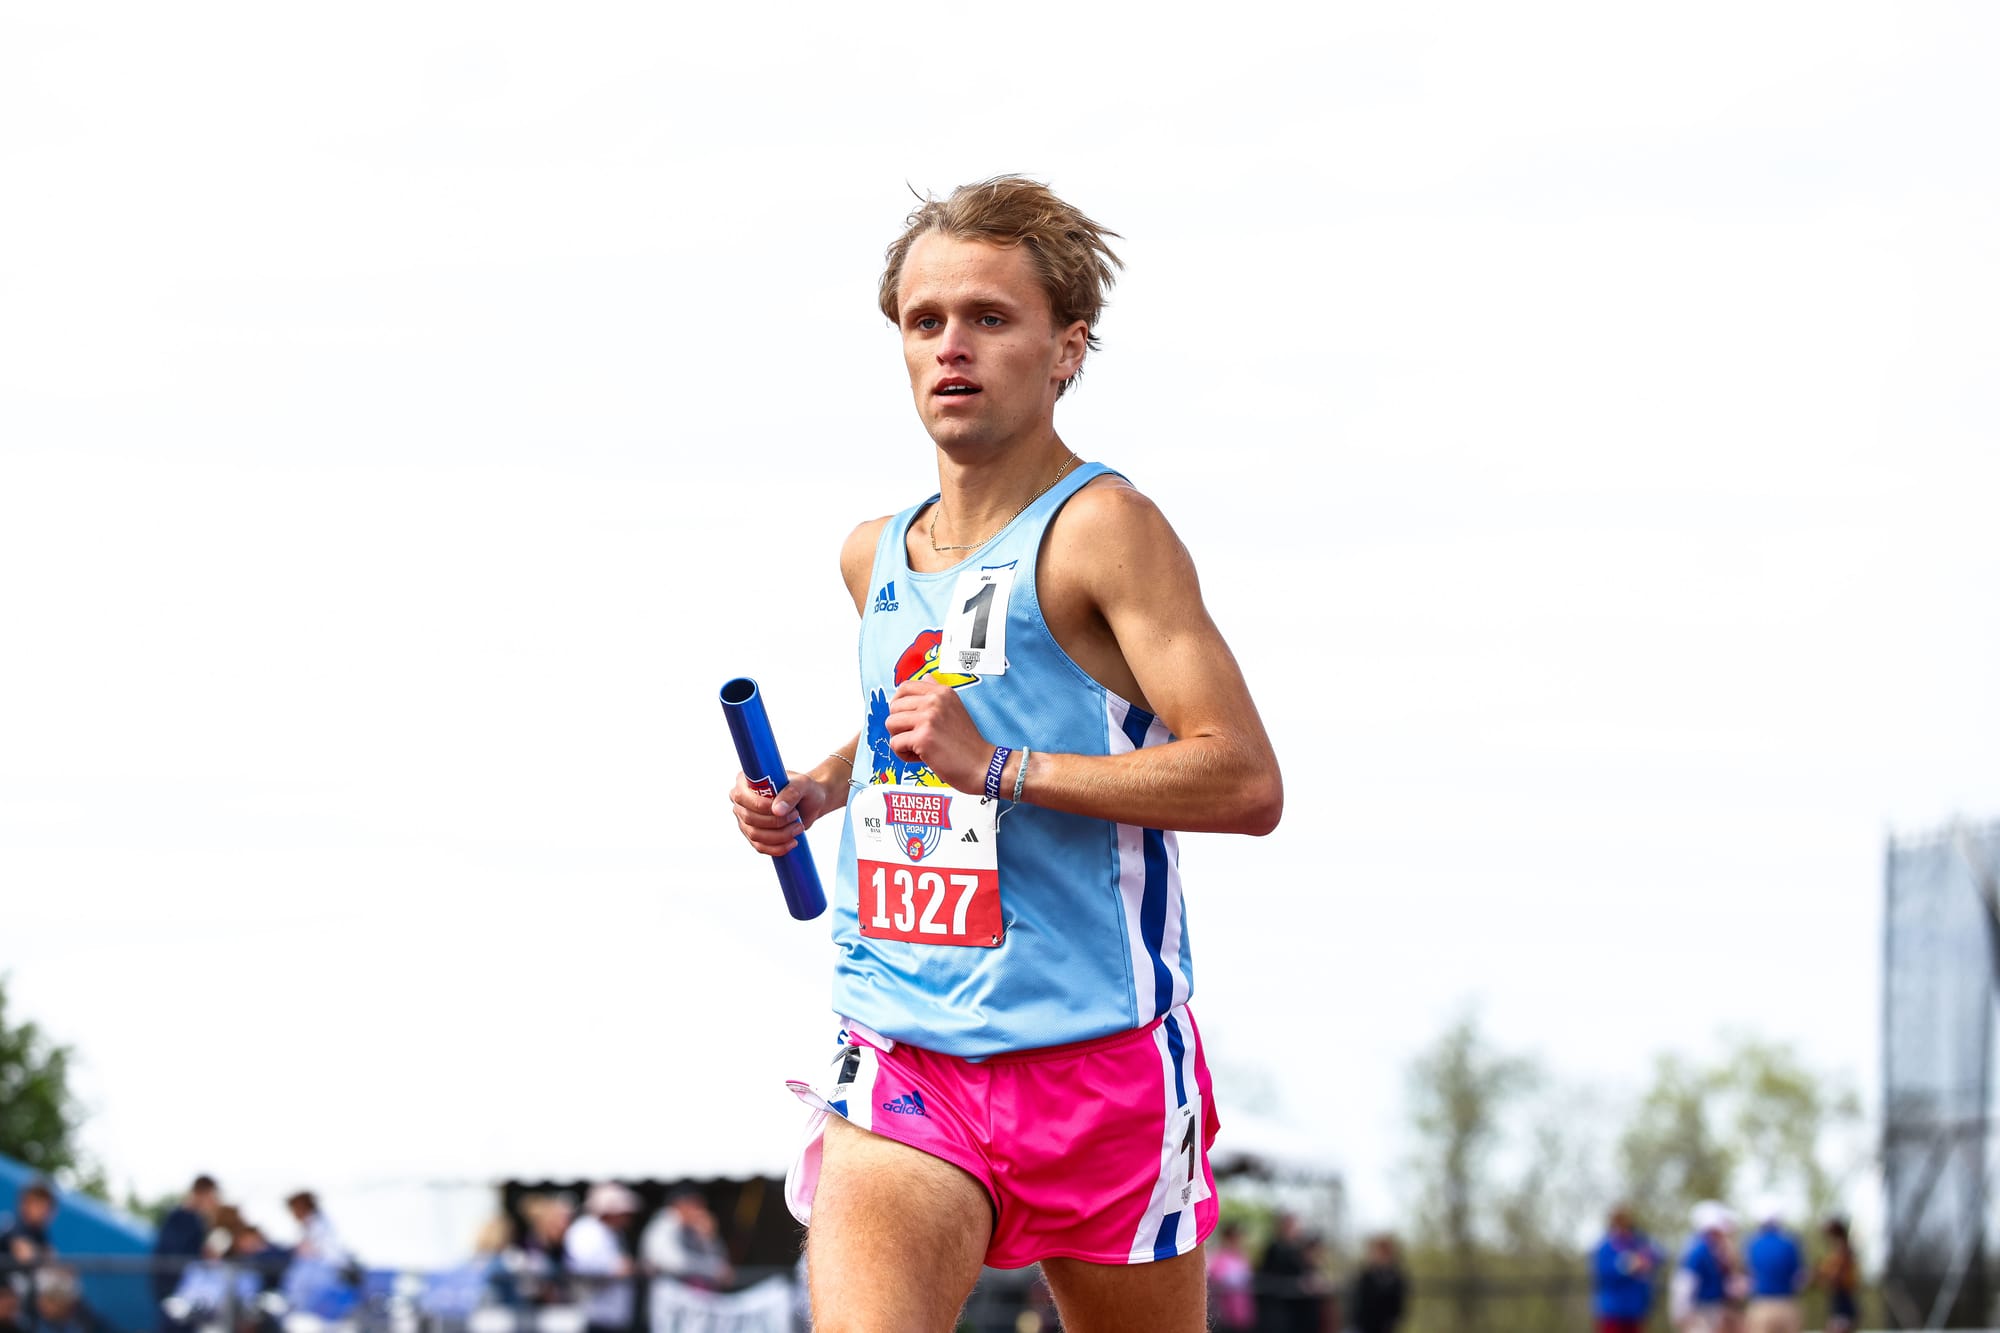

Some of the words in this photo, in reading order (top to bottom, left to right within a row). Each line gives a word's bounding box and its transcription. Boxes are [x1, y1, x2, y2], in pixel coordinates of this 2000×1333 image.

[963, 583, 997, 649] 1
[891, 795, 941, 811] KANSAS
[864, 817, 881, 828] RCB
[893, 808, 940, 825] RELAYS
[906, 825, 925, 835] 2024
[872, 867, 979, 936] 1327
[882, 1102, 932, 1119] adida
[1180, 1114, 1196, 1183] 1
